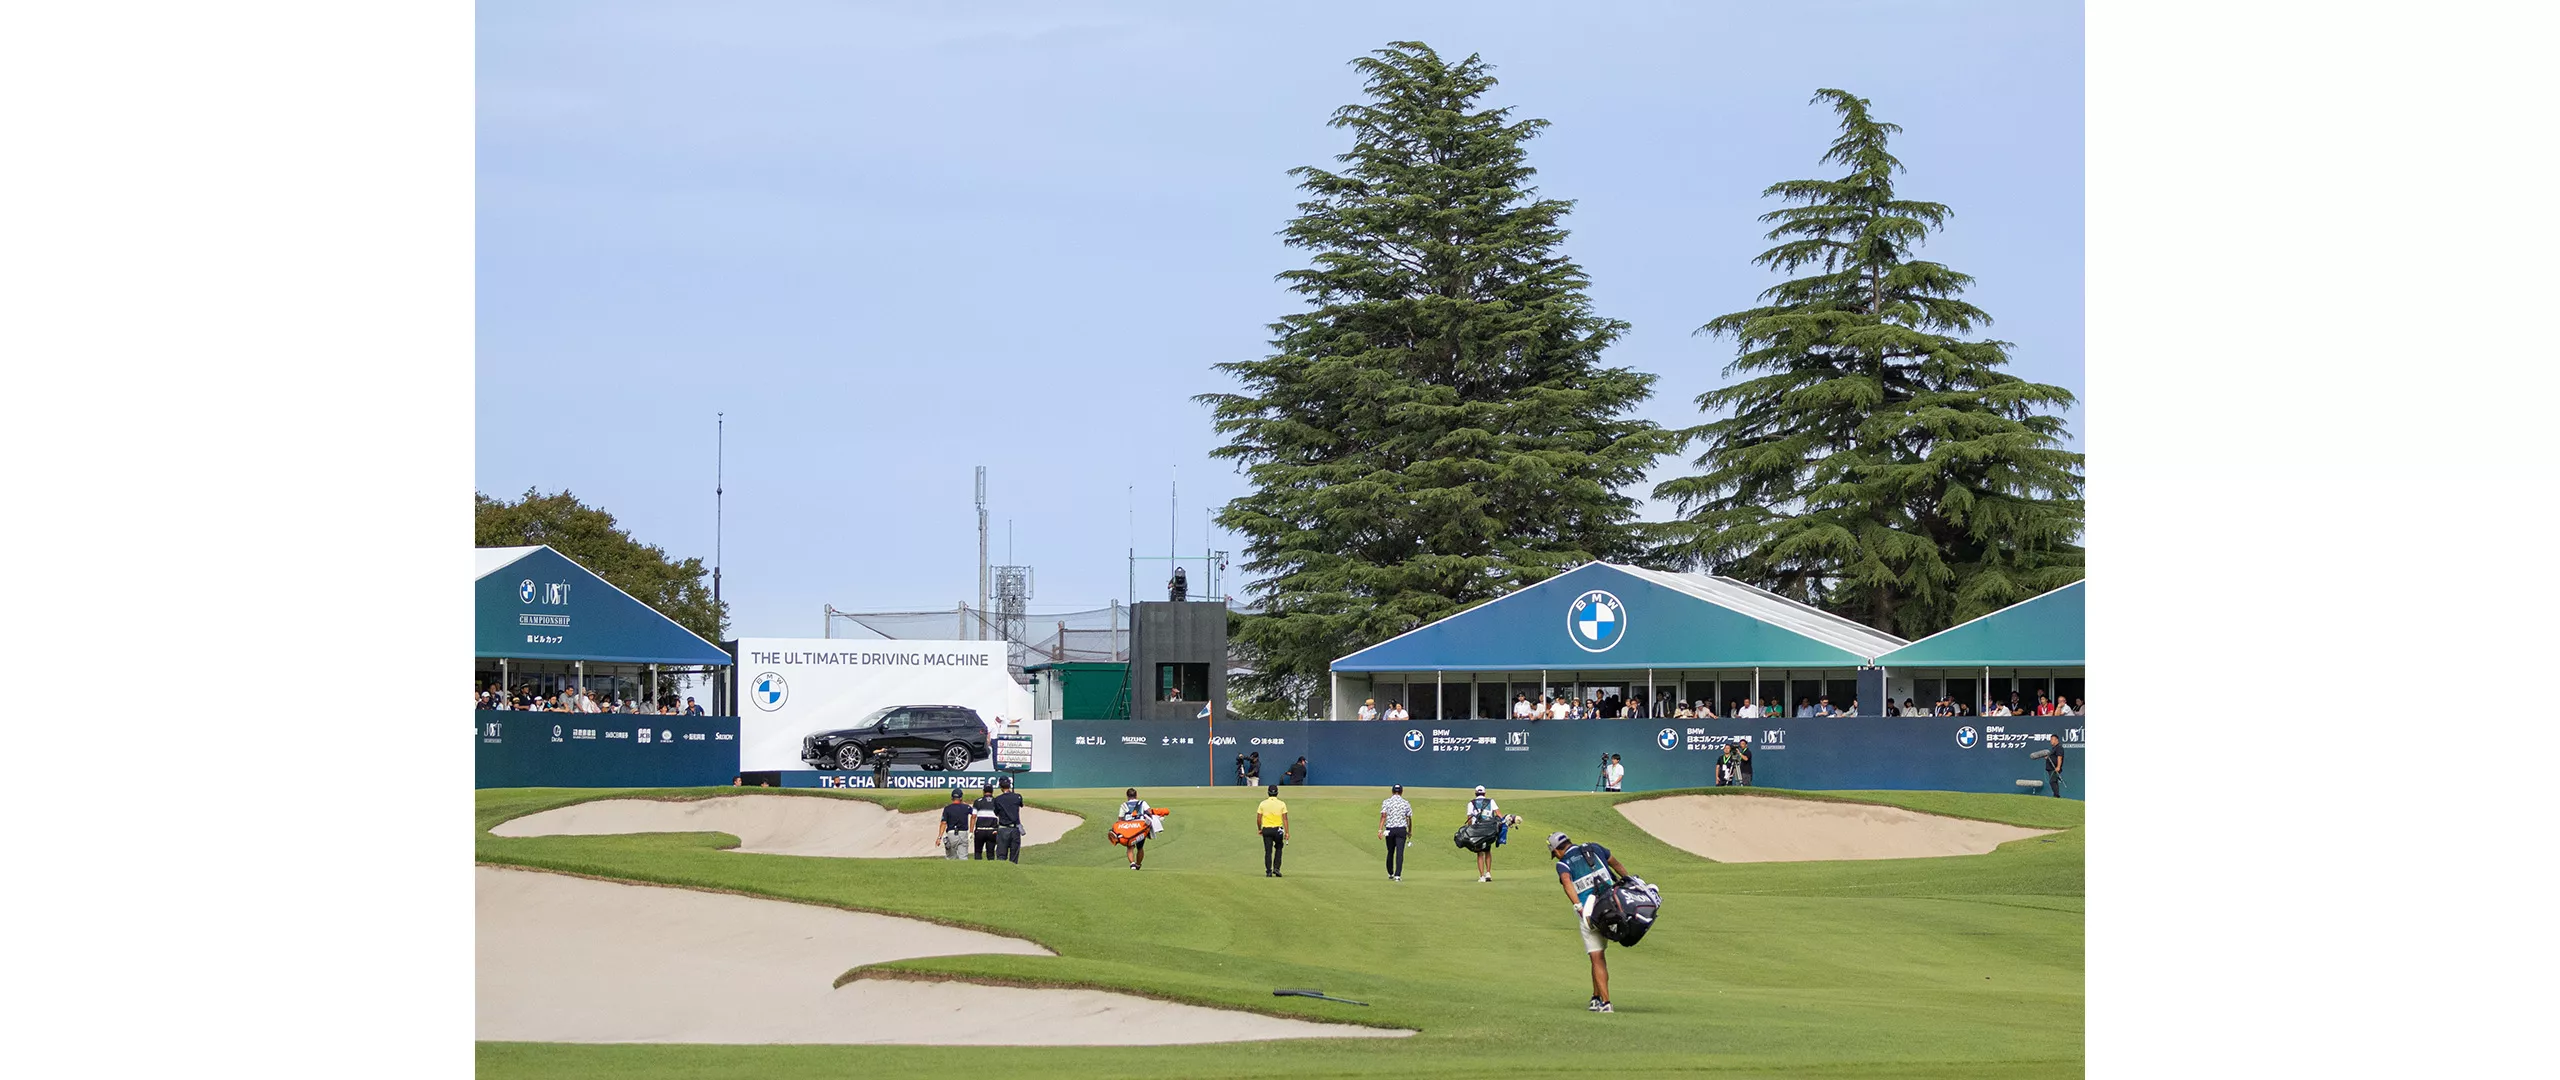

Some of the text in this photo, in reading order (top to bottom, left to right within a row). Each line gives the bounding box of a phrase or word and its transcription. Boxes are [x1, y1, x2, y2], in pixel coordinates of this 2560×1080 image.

[1575, 593, 1619, 612] BMW
[519, 615, 570, 625] CHAMPIONSHIP
[751, 652, 989, 666] THE ULTIMATE DRIVING MACHINE
[756, 673, 784, 685] BMW
[1075, 736, 1106, 745] 森ビル
[848, 776, 946, 788] CHAPIONSHIP
[948, 776, 985, 788] PRIZE
